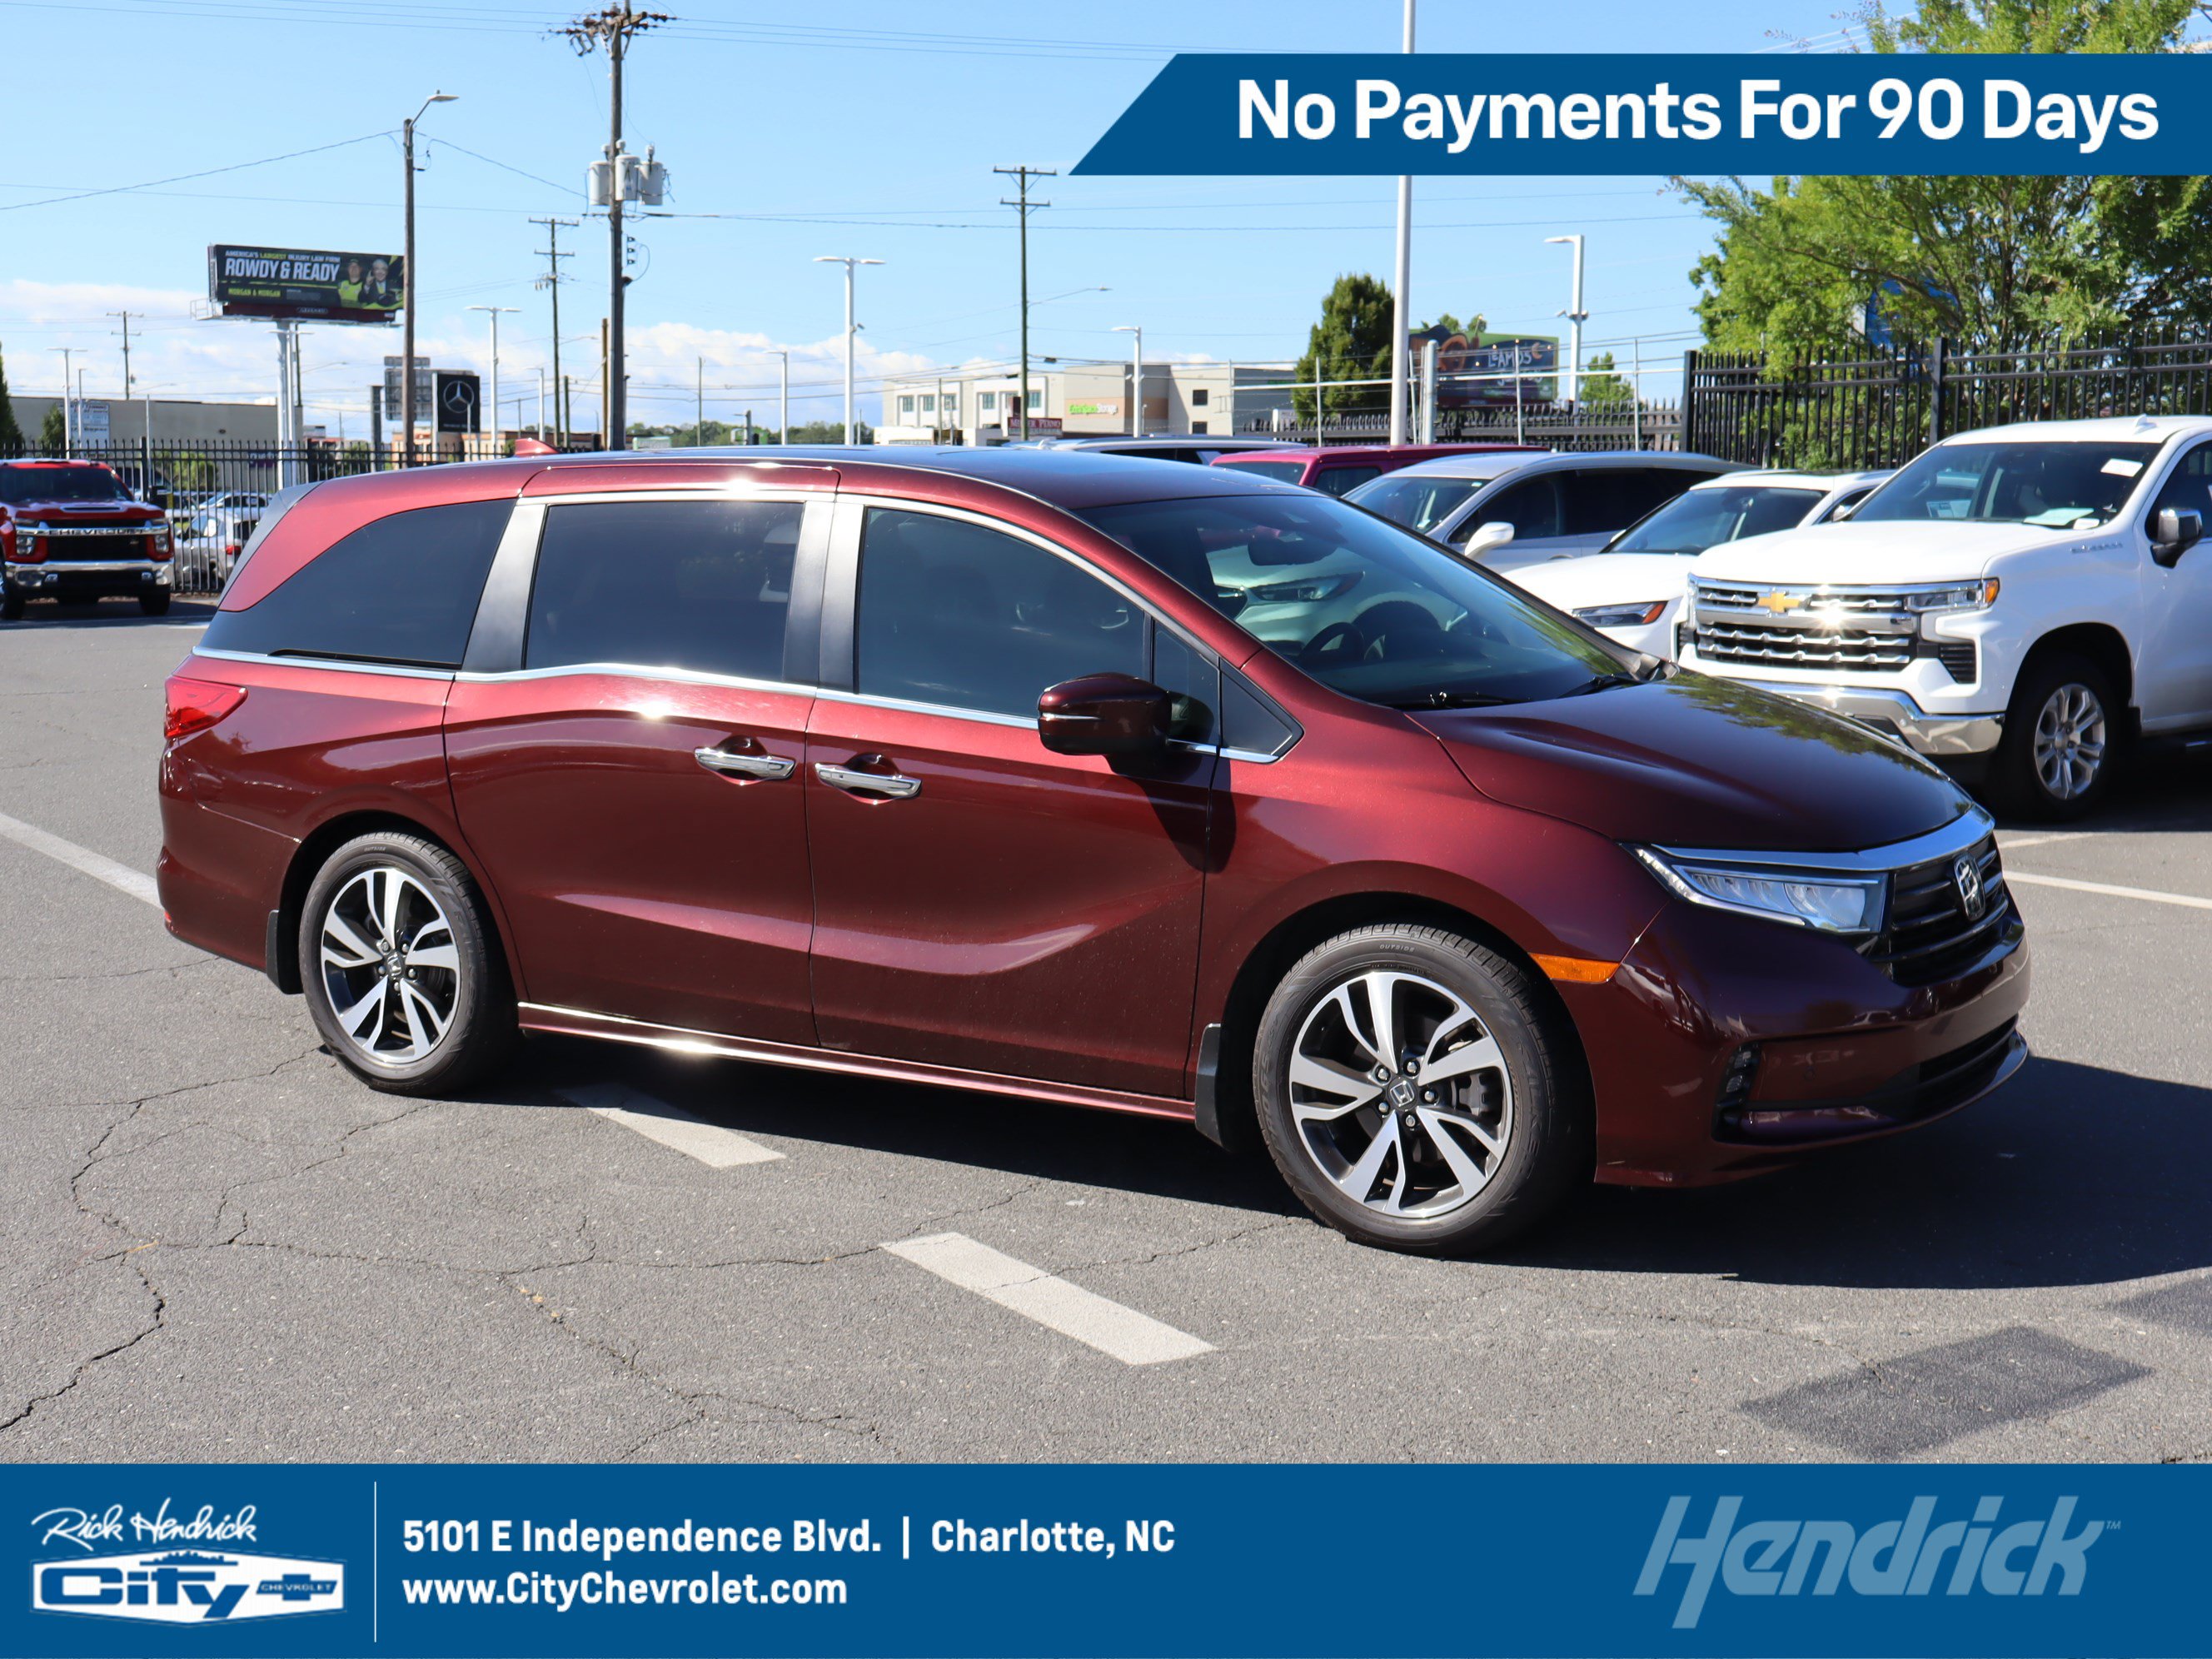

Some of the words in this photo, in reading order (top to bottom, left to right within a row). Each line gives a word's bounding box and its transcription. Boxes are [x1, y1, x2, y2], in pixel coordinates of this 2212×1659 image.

[225, 250, 258, 258] AMERICA'S
[225, 257, 279, 279] ROWDY
[280, 262, 291, 280] &
[292, 262, 341, 281] READY
[227, 288, 252, 296] MORGAN
[257, 289, 281, 297] MORGAN
[1379, 944, 1415, 953] OUTSIDE
